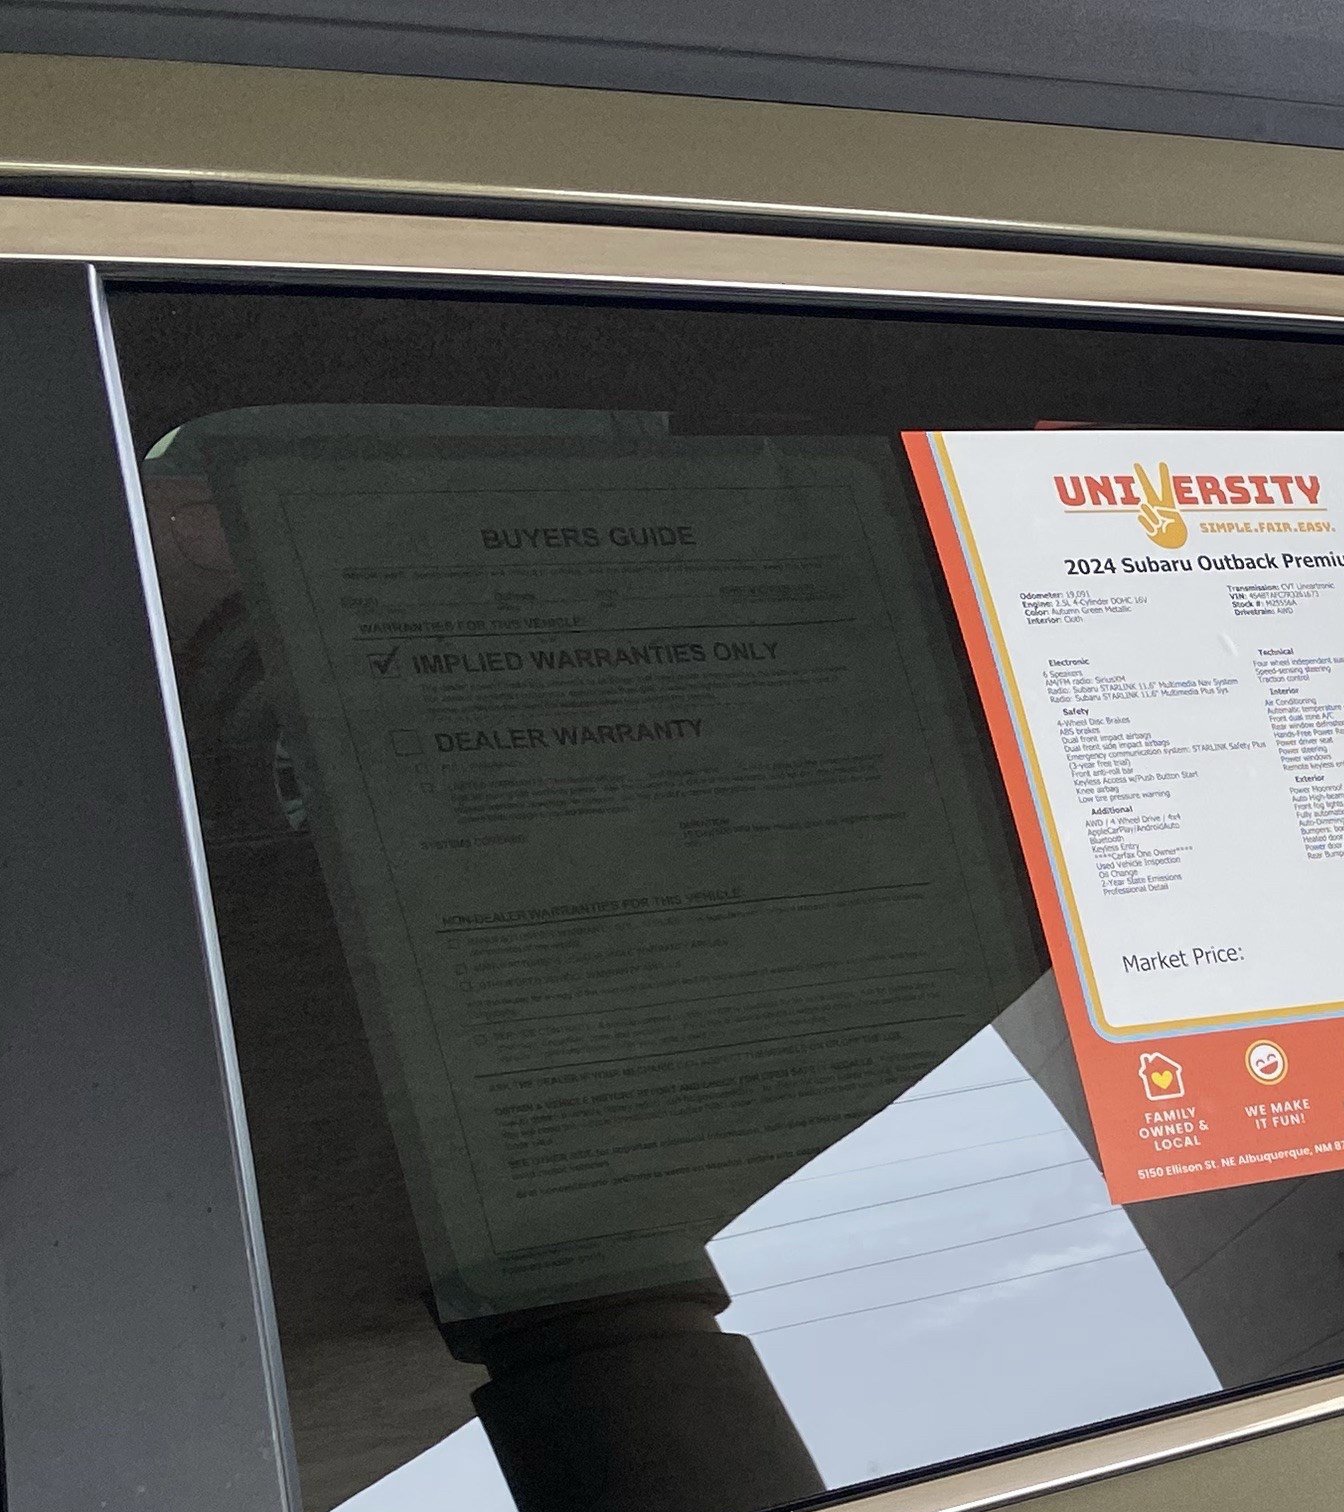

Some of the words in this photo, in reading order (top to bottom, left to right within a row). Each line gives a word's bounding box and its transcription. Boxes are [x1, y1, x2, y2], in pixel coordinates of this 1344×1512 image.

[1053, 464, 1321, 510] UNIVERSITY
[481, 526, 600, 550] BUYERS
[608, 525, 697, 548] GUIDE
[1064, 557, 1117, 576] 2024
[1121, 555, 1193, 574] Subaru
[1198, 552, 1279, 572] Outback
[1021, 600, 1054, 609] Engine:
[411, 651, 523, 675] IMPLIED
[529, 643, 707, 670] WARRANTIES
[713, 641, 779, 663] ONLY
[1048, 658, 1090, 666] Electronic
[1062, 707, 1089, 716] Safety
[435, 729, 549, 754] DEALER
[552, 717, 703, 747] WARRANTY
[1091, 806, 1133, 814] Additional
[1122, 950, 1189, 975] Market
[1193, 945, 1246, 967] Price:
[1269, 1098, 1311, 1113] MAKE
[1143, 1106, 1197, 1123] FAMILY
[1271, 1113, 1306, 1127] FUN!
[1138, 1122, 1194, 1139] OWNED
[1153, 1135, 1201, 1151] LOCAL
[1137, 1166, 1164, 1179] 5150
[1165, 1161, 1202, 1175] Ellison
[1203, 1158, 1219, 1169] St.
[1237, 1145, 1313, 1166] Albuquerque,
